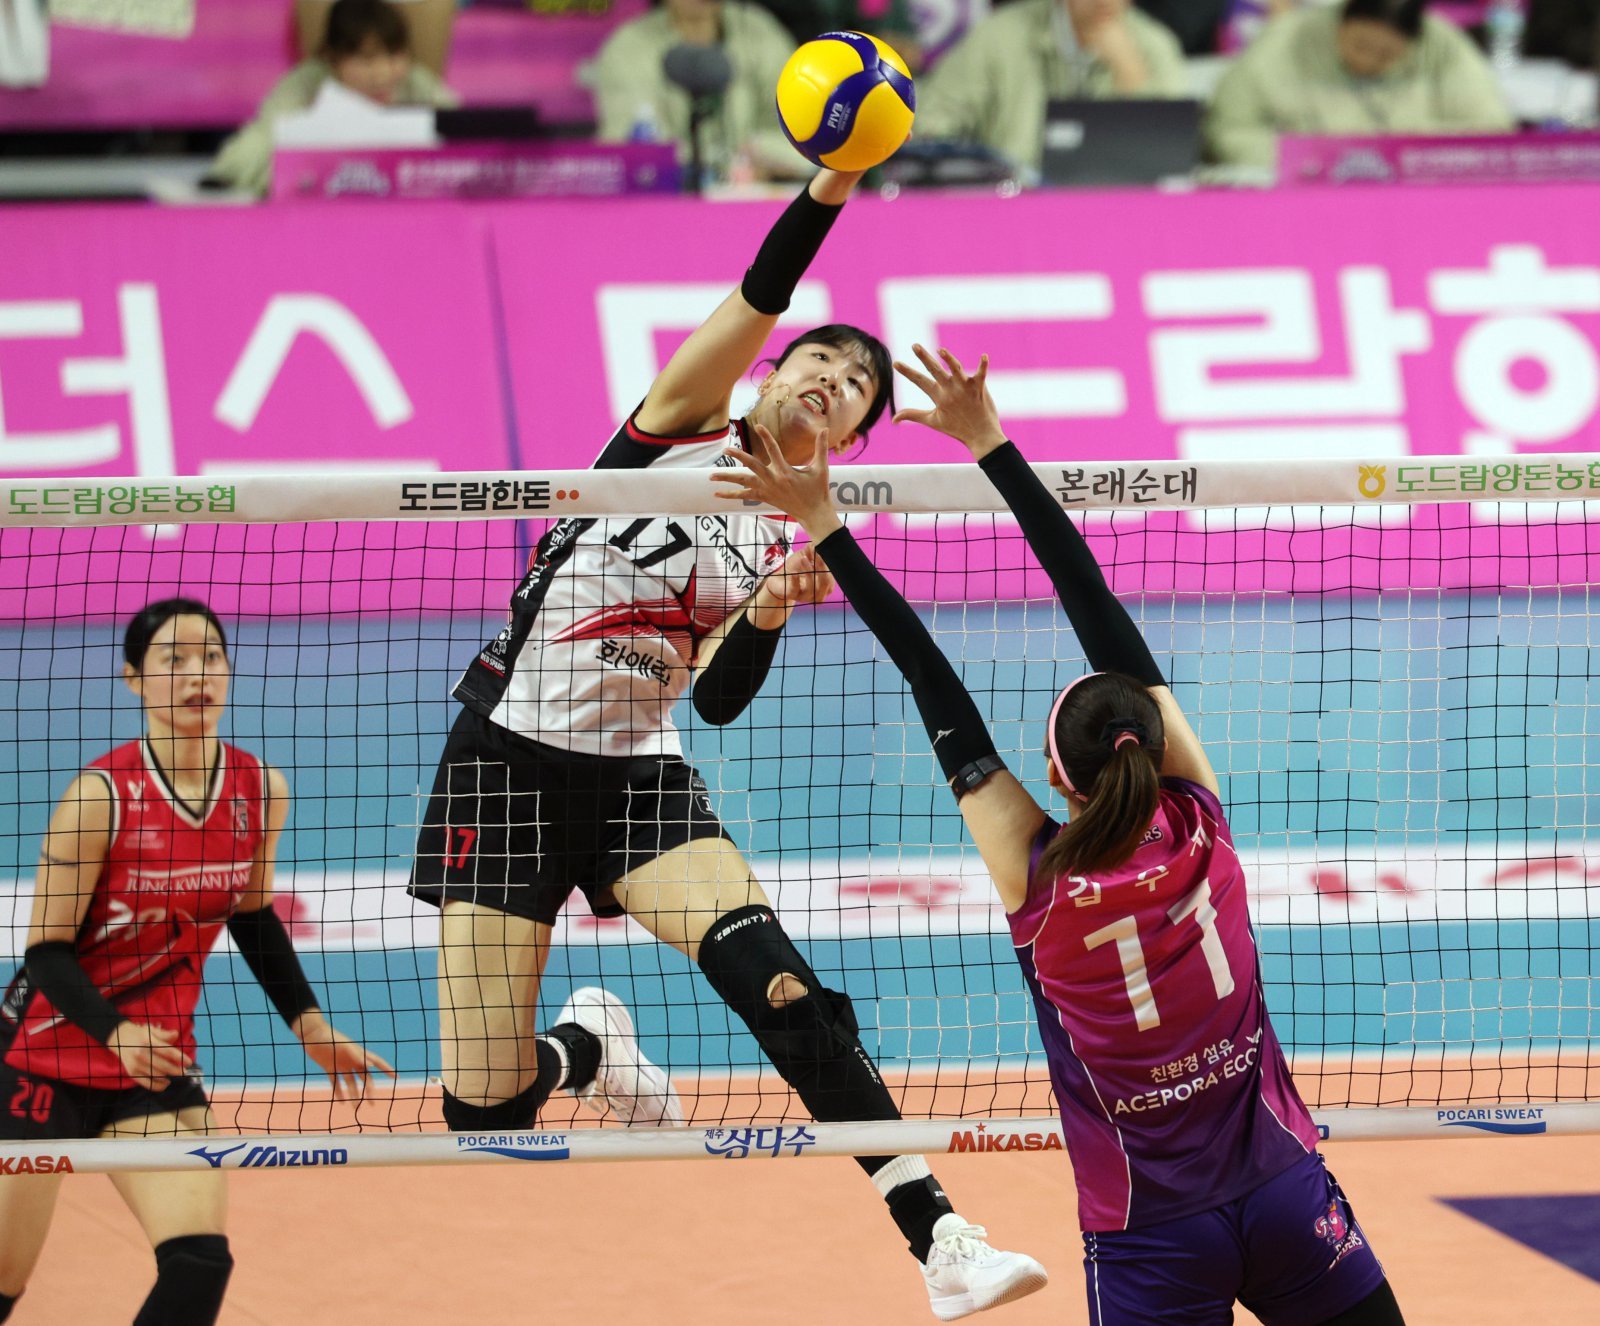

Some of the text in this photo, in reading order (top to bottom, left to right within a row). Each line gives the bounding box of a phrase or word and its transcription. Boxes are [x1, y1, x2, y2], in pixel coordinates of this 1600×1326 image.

[827, 102, 844, 128] FIVB
[8, 484, 236, 515] 도드람양돈농협
[399, 480, 550, 512] 도드람한돈
[1056, 467, 1197, 503] 본래순대
[596, 639, 671, 688] 화애락
[441, 826, 477, 869] 17
[1150, 1038, 1236, 1084] 친환경 섬유
[9, 1076, 55, 1124] 20
[1437, 1108, 1544, 1121] POCARI SWEAT
[457, 1134, 567, 1147] POCARI SWEAT
[704, 1126, 816, 1159] 제주 삼다수
